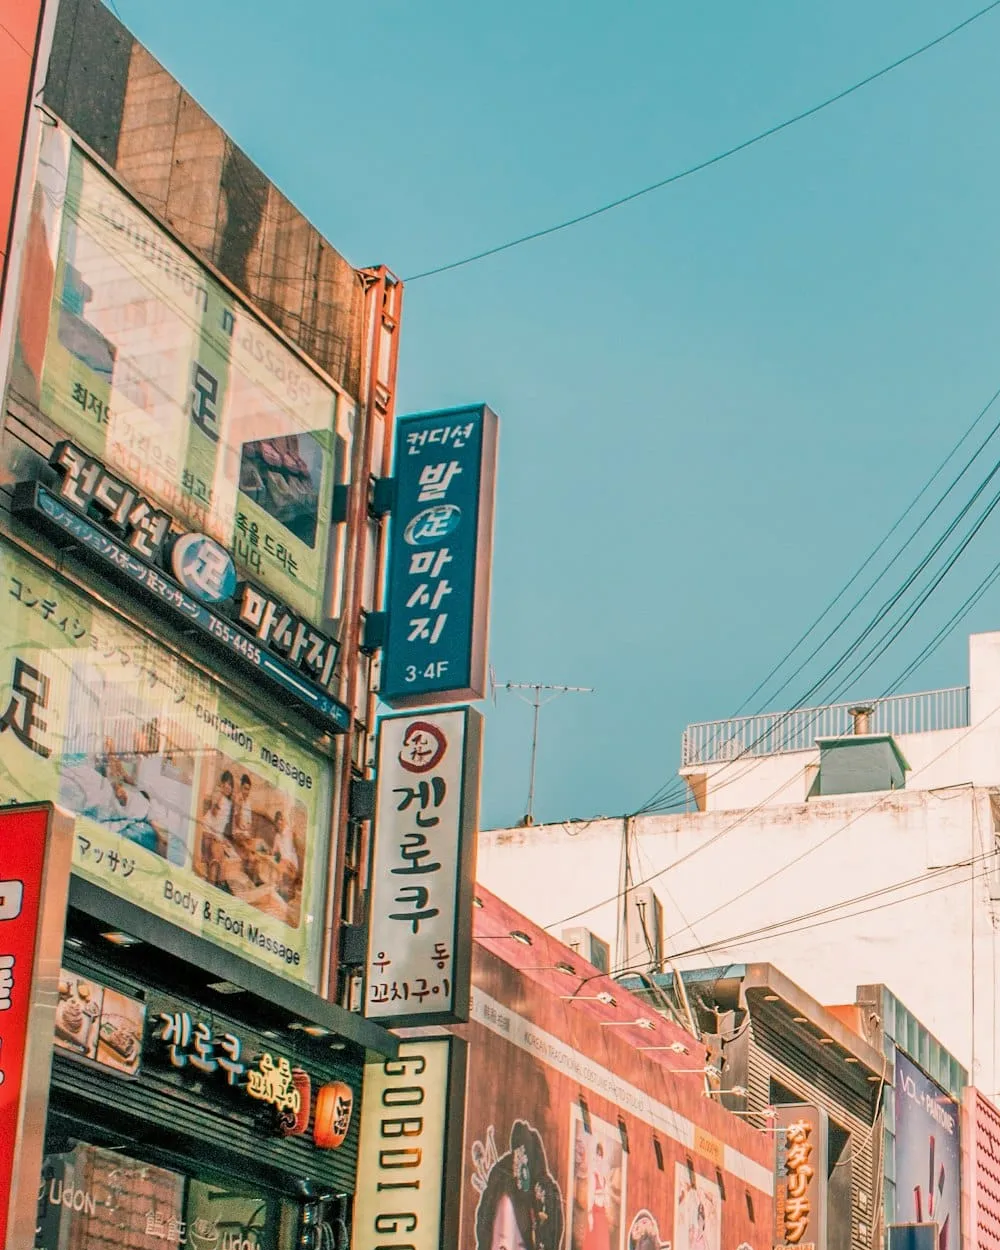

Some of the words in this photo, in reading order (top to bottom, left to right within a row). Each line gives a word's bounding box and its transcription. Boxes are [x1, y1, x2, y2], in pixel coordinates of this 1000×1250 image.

[406, 424, 473, 455] 컨디션
[56, 444, 170, 556] 컨디션
[240, 586, 339, 684] 마사지
[260, 744, 313, 791] massage
[389, 776, 446, 934] 겐로쿠
[163, 878, 199, 914] Body
[203, 901, 212, 920] &
[216, 903, 245, 939] Foot
[248, 924, 301, 966] Massage
[370, 978, 450, 1003] 꼬치구이
[159, 1010, 248, 1086] 겐로쿠
[376, 1055, 427, 1192] GOBDI
[900, 1069, 920, 1105] VDL
